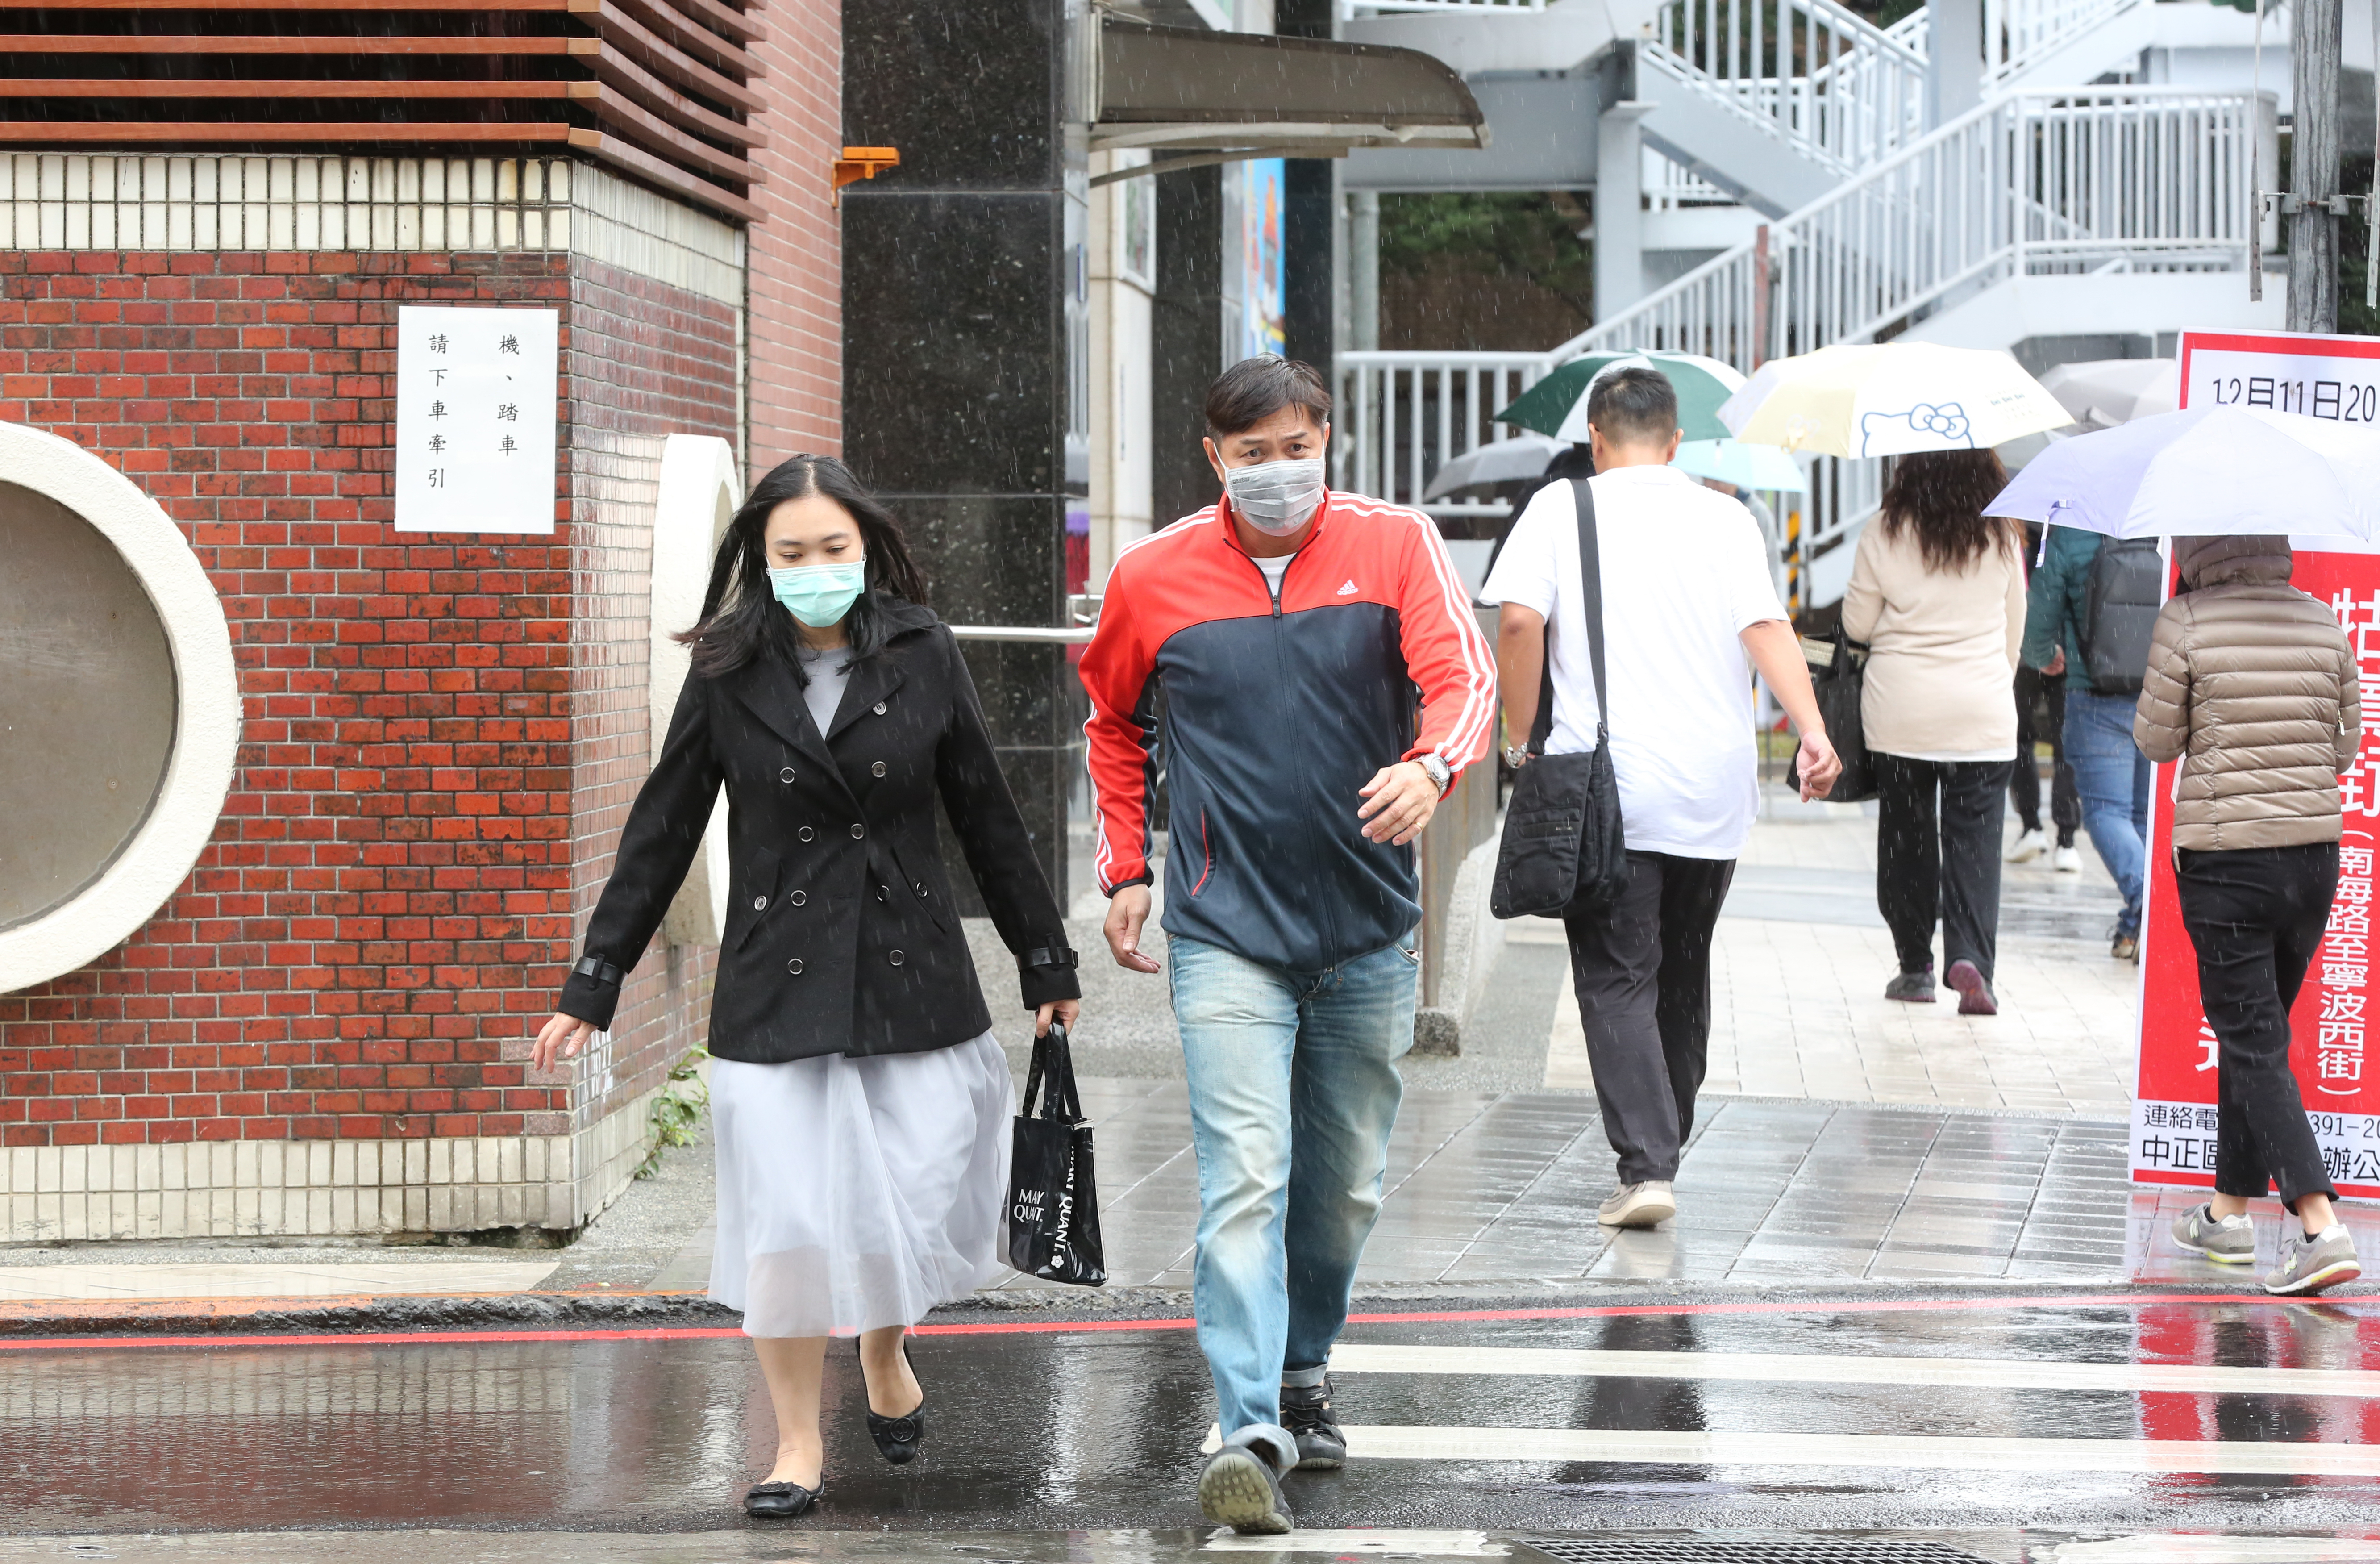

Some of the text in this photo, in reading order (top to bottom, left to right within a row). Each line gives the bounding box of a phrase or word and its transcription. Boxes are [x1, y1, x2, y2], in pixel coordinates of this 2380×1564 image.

[428, 334, 449, 488] 請下車牽引
[497, 334, 520, 456] 機、踏車
[1337, 587, 1358, 596] adidas
[2144, 1104, 2218, 1131] 連絡電
[1054, 1196, 1073, 1252] QUANT
